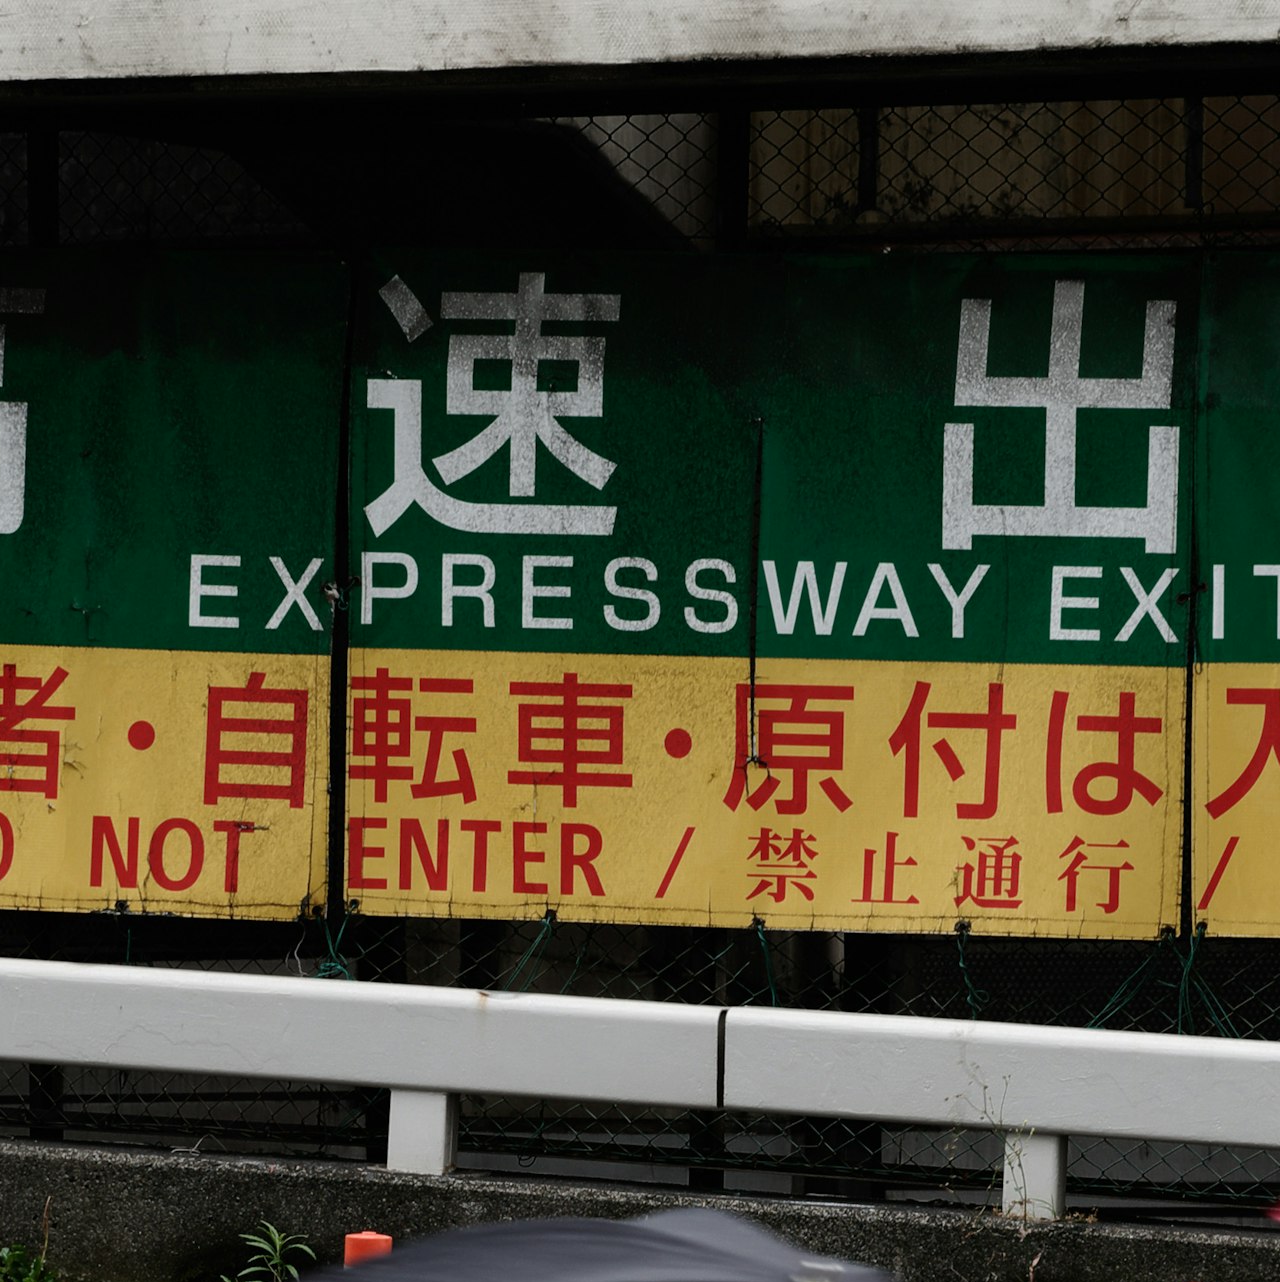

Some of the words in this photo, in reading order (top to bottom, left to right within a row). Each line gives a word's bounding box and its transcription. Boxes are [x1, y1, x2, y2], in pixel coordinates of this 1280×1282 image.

[189, 551, 990, 640] EXPRESSWAY
[89, 815, 257, 894] NOT
[347, 815, 606, 898] ENTER
[746, 827, 1135, 914] 禁止通行
